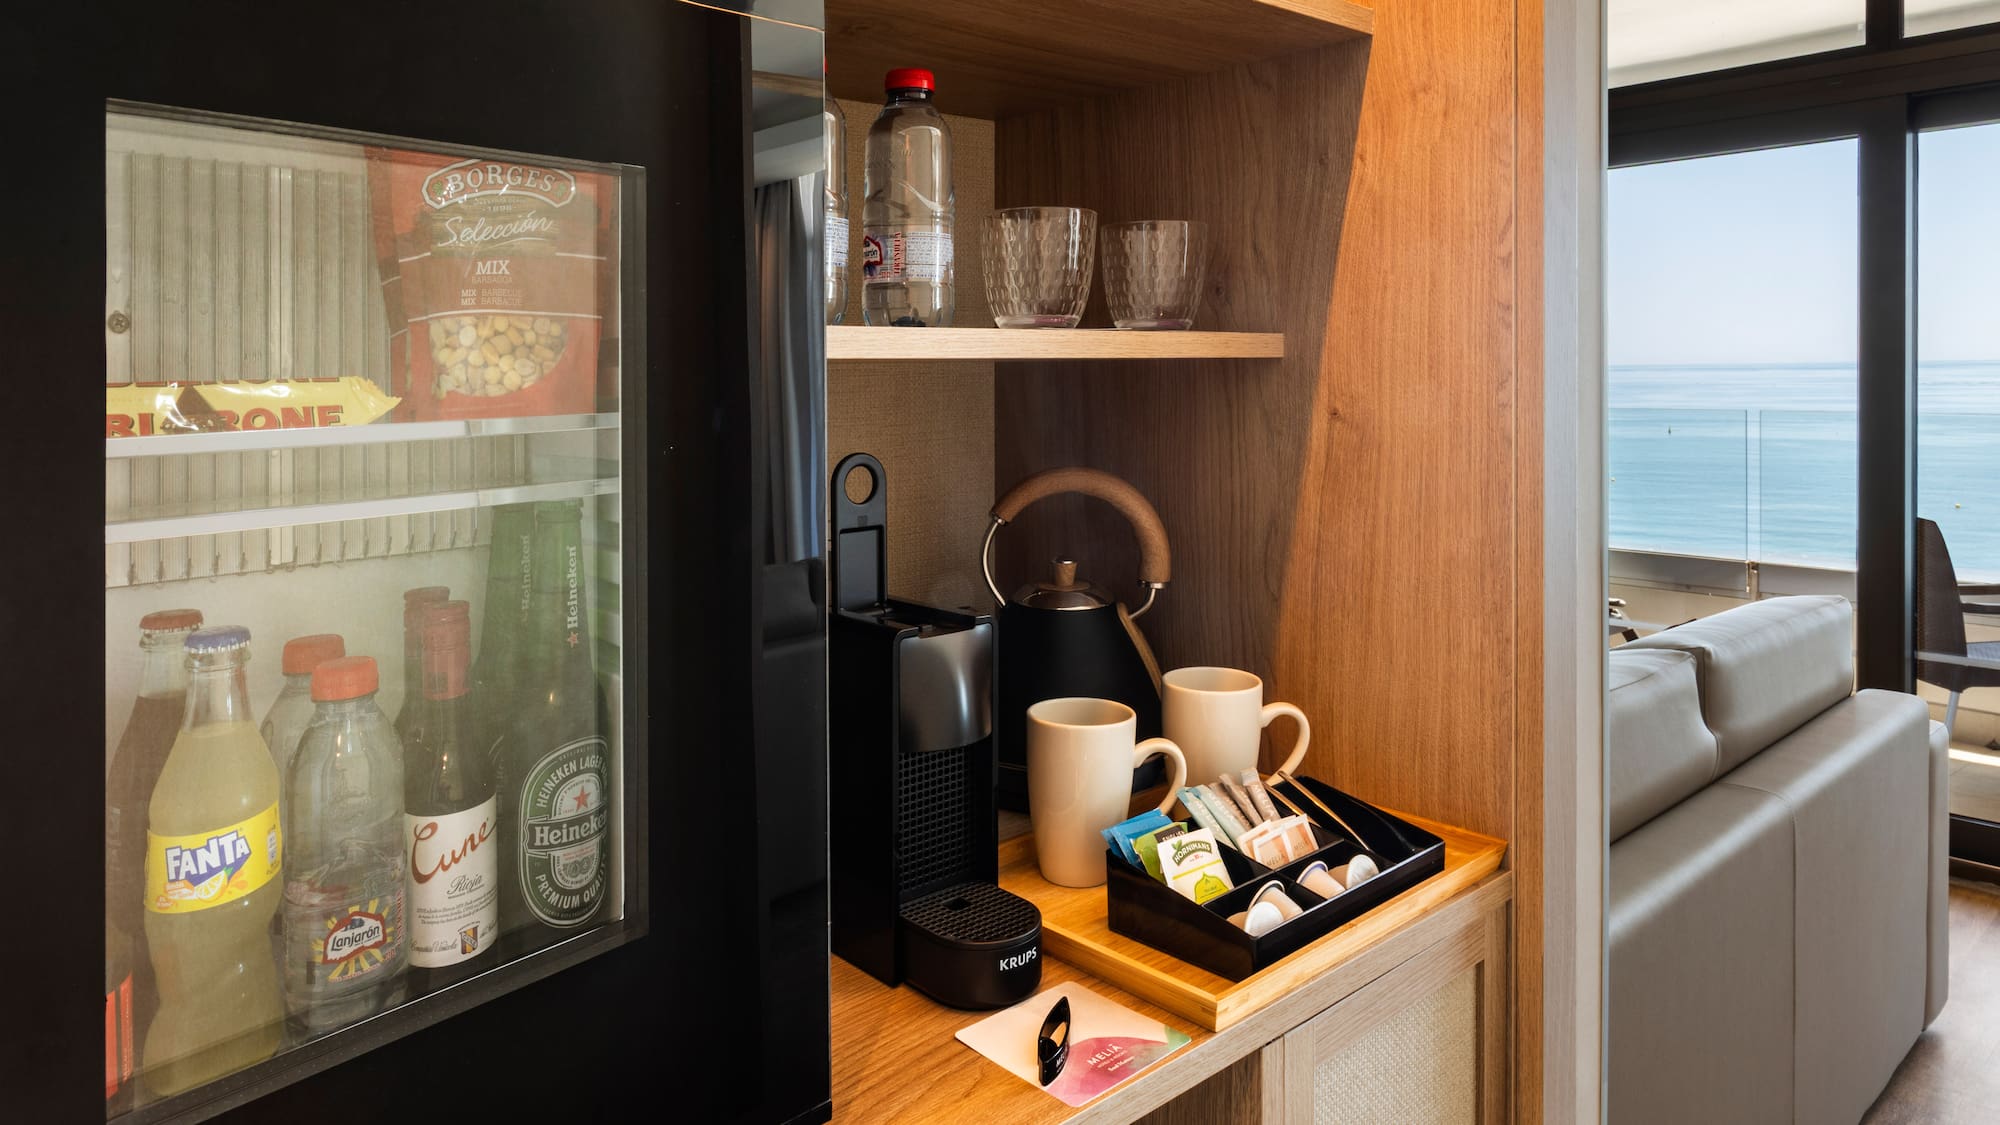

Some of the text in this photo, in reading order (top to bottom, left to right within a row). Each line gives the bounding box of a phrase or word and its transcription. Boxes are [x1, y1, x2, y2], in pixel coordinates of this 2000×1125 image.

[446, 165, 556, 193] BORGES
[437, 211, 554, 247] Selección
[475, 259, 511, 275] MIX
[460, 297, 477, 306] MIX
[461, 288, 477, 298] MIX
[566, 545, 579, 630] Heineken
[536, 759, 577, 808] HEINEKEN
[579, 755, 603, 771] LAGER
[166, 832, 251, 882] FANTA
[1174, 842, 1212, 863] HORNIMANS
[447, 874, 485, 895] Rioja
[536, 873, 581, 909] PREMIUM
[331, 926, 380, 952] Lanjarón
[999, 946, 1037, 971] KRUPS
